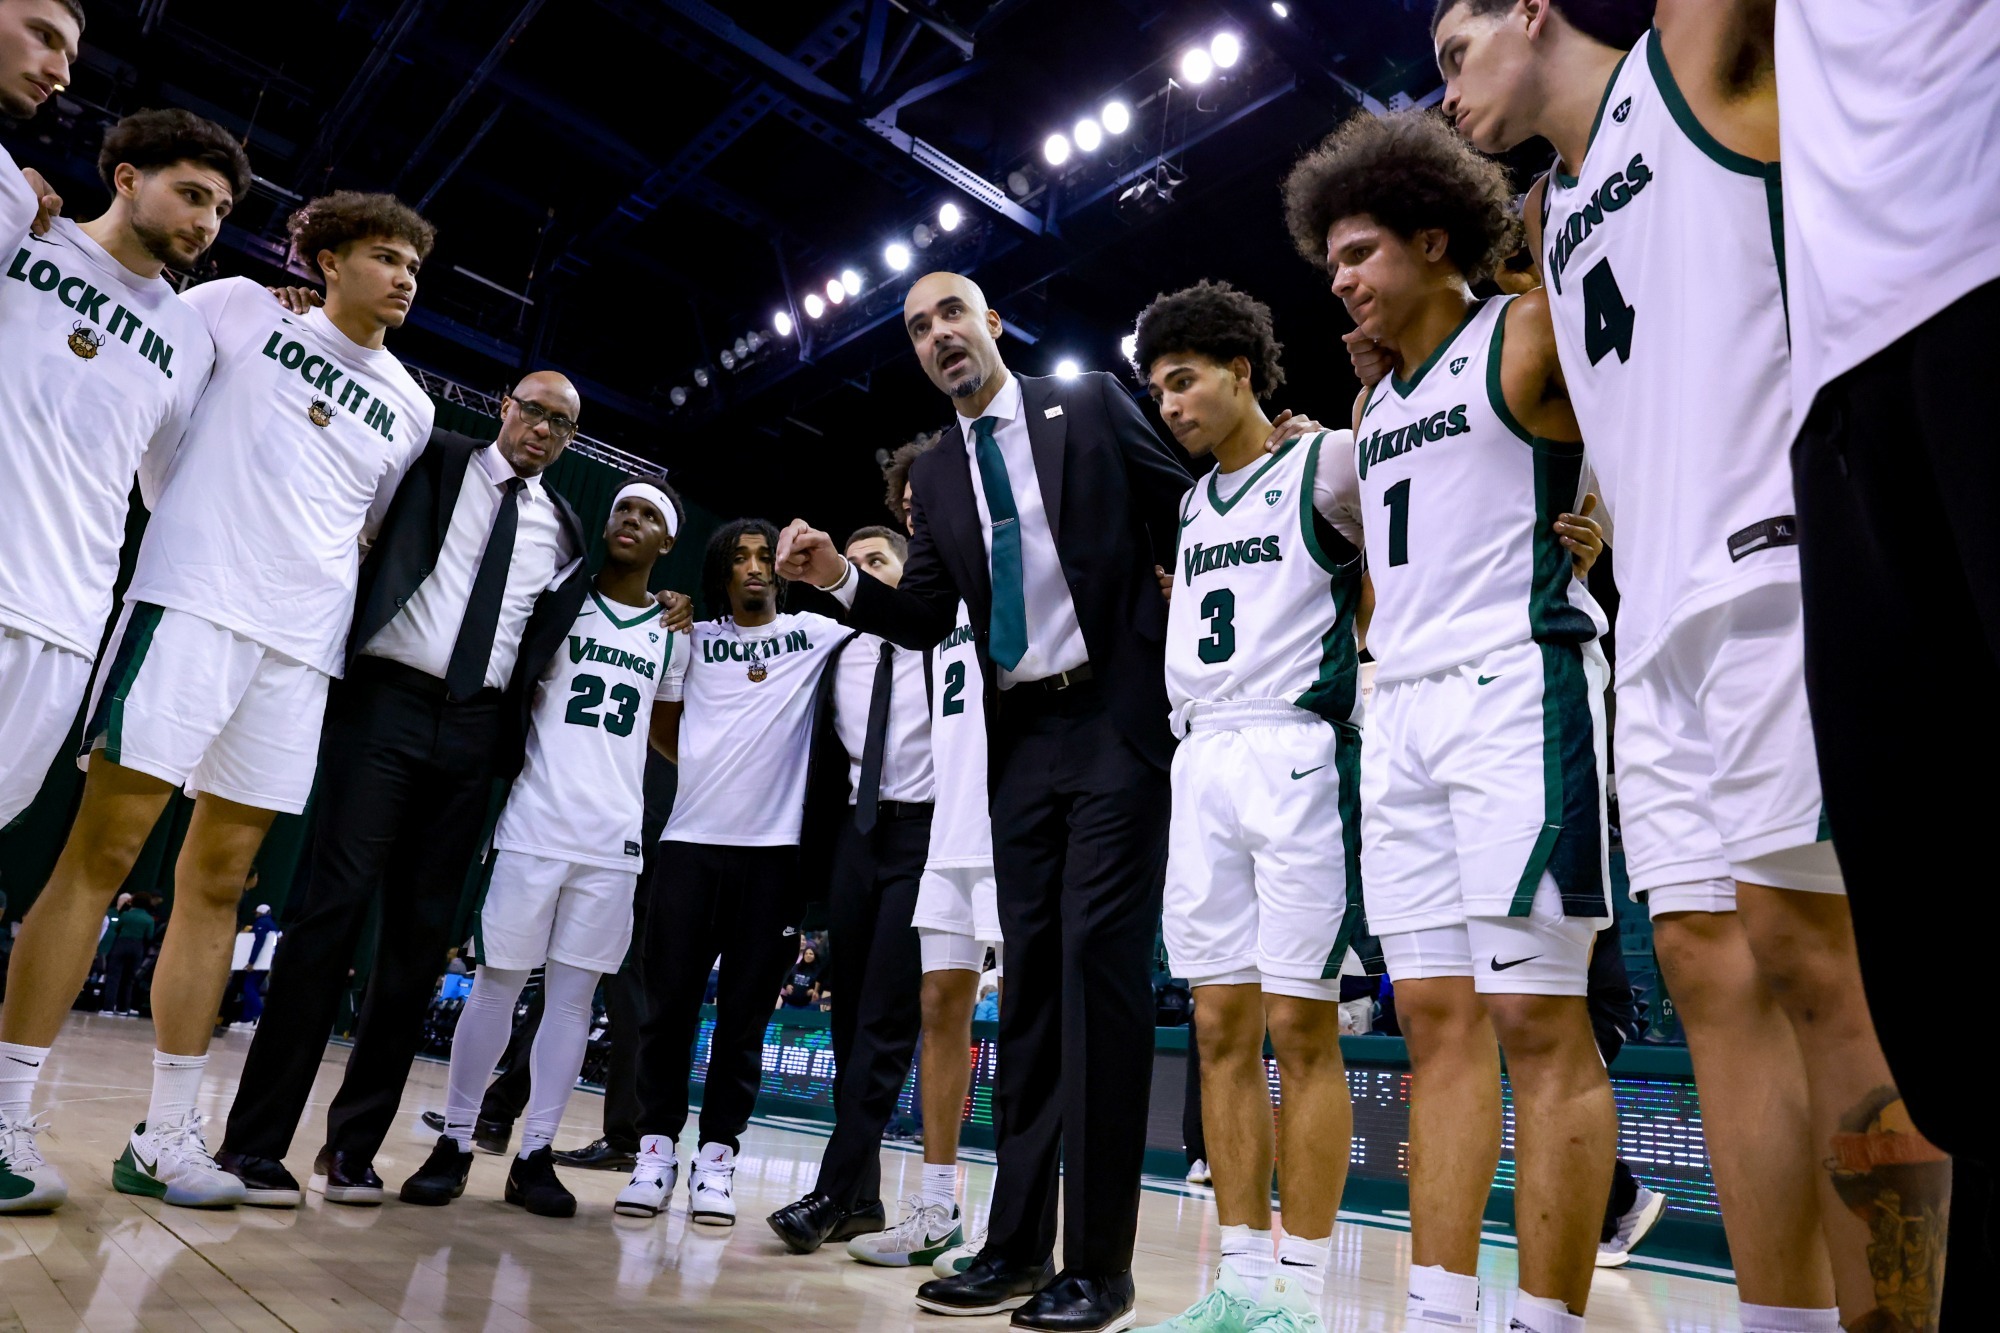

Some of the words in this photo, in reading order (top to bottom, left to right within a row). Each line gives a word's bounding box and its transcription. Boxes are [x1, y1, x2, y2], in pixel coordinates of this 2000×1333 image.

[1549, 153, 1653, 295] VIKINGS
[7, 248, 110, 325] LOCK
[106, 304, 142, 344] IT
[139, 328, 174, 379] IN.
[1583, 256, 1635, 367] 4
[262, 331, 343, 398] LOCK
[337, 379, 369, 414] IT
[363, 397, 396, 442] IN.
[1359, 404, 1470, 480] VIKINGS
[1384, 478, 1410, 567] 1
[1775, 525, 1791, 536] XL
[1184, 535, 1282, 587] VIKINGS
[568, 635, 656, 680] VIKINGS
[703, 639, 760, 663] LOCK
[785, 630, 814, 652] IN.
[940, 624, 975, 660] IKING
[1198, 588, 1235, 664] 3
[565, 673, 640, 737] 23
[943, 660, 965, 717] 2
